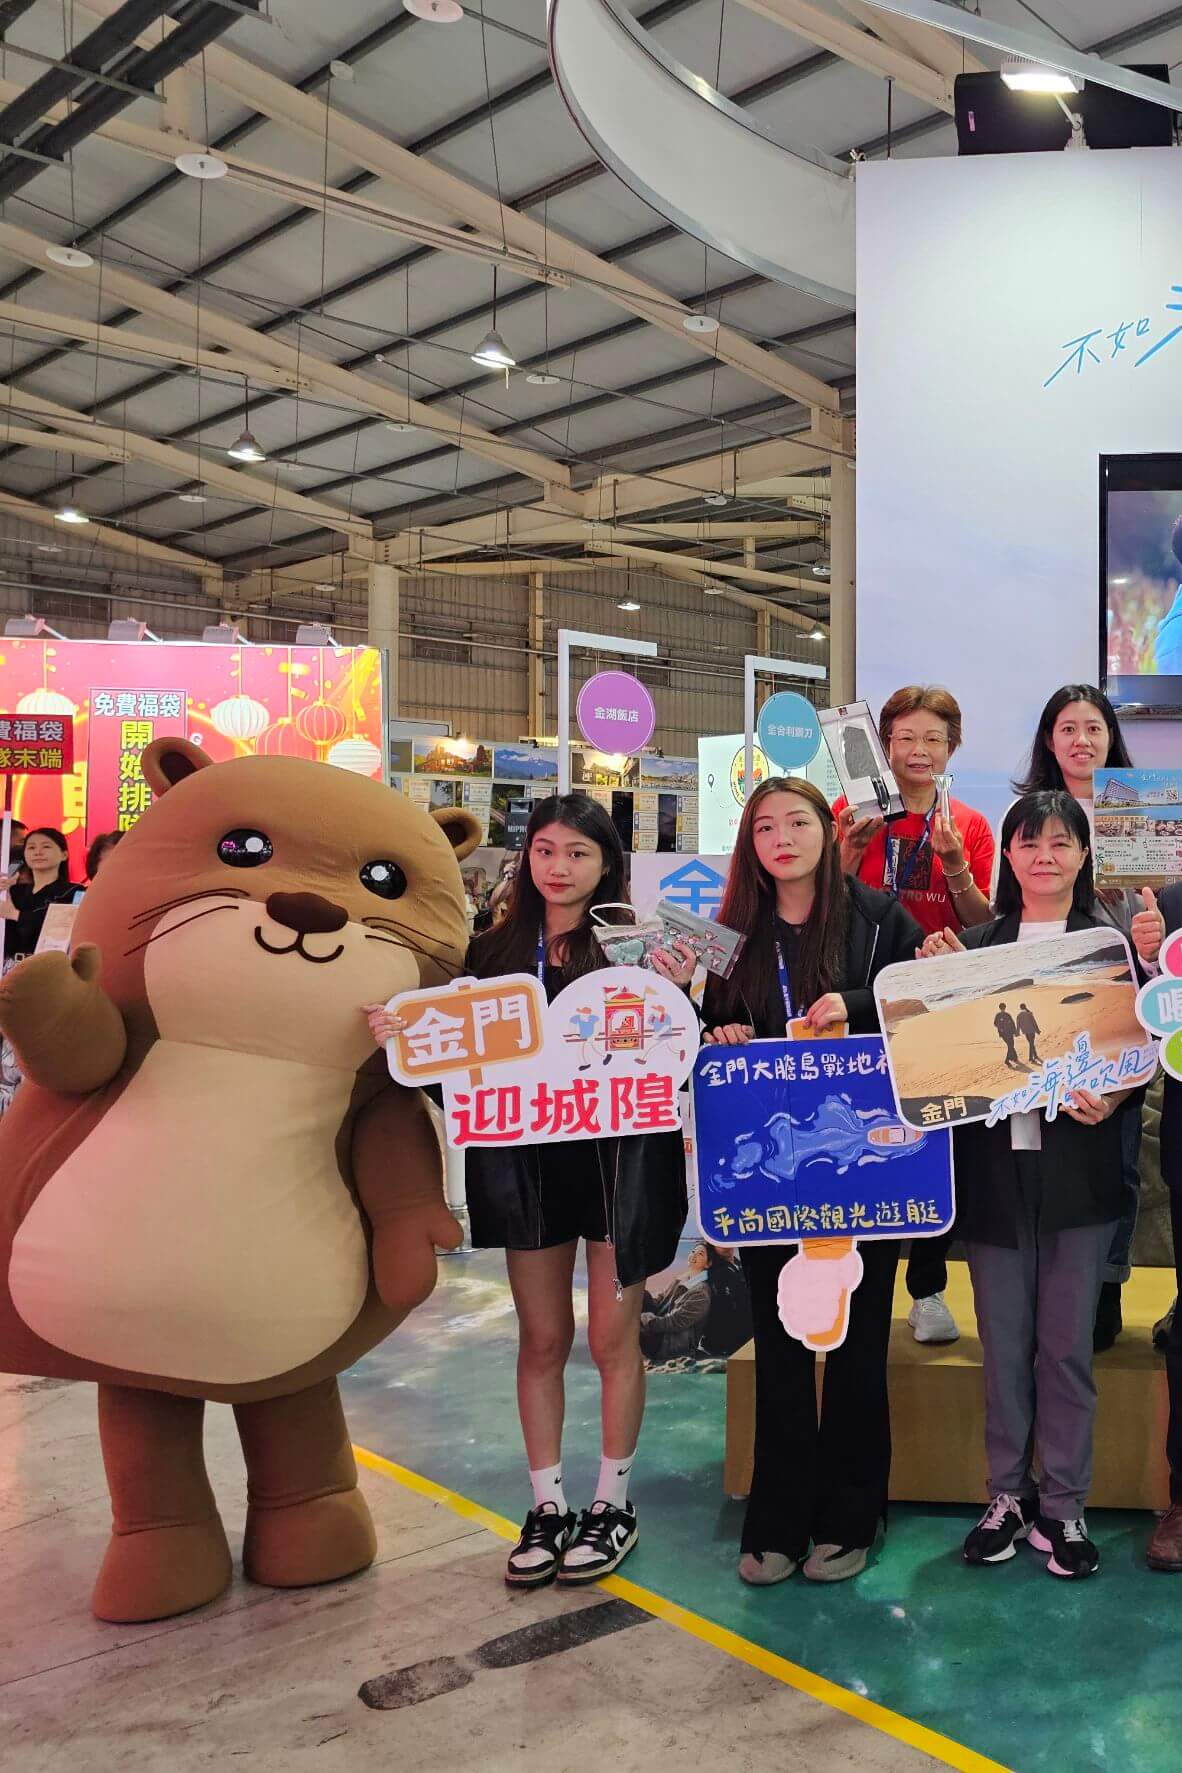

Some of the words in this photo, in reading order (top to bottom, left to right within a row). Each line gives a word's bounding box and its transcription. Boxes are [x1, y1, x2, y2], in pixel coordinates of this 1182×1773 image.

[94, 692, 182, 718] 免費福袋
[593, 705, 640, 724] 金湖飯店
[402, 992, 532, 1067] 金門
[450, 1072, 678, 1146] 迎城隍
[920, 1096, 968, 1124] 金門
